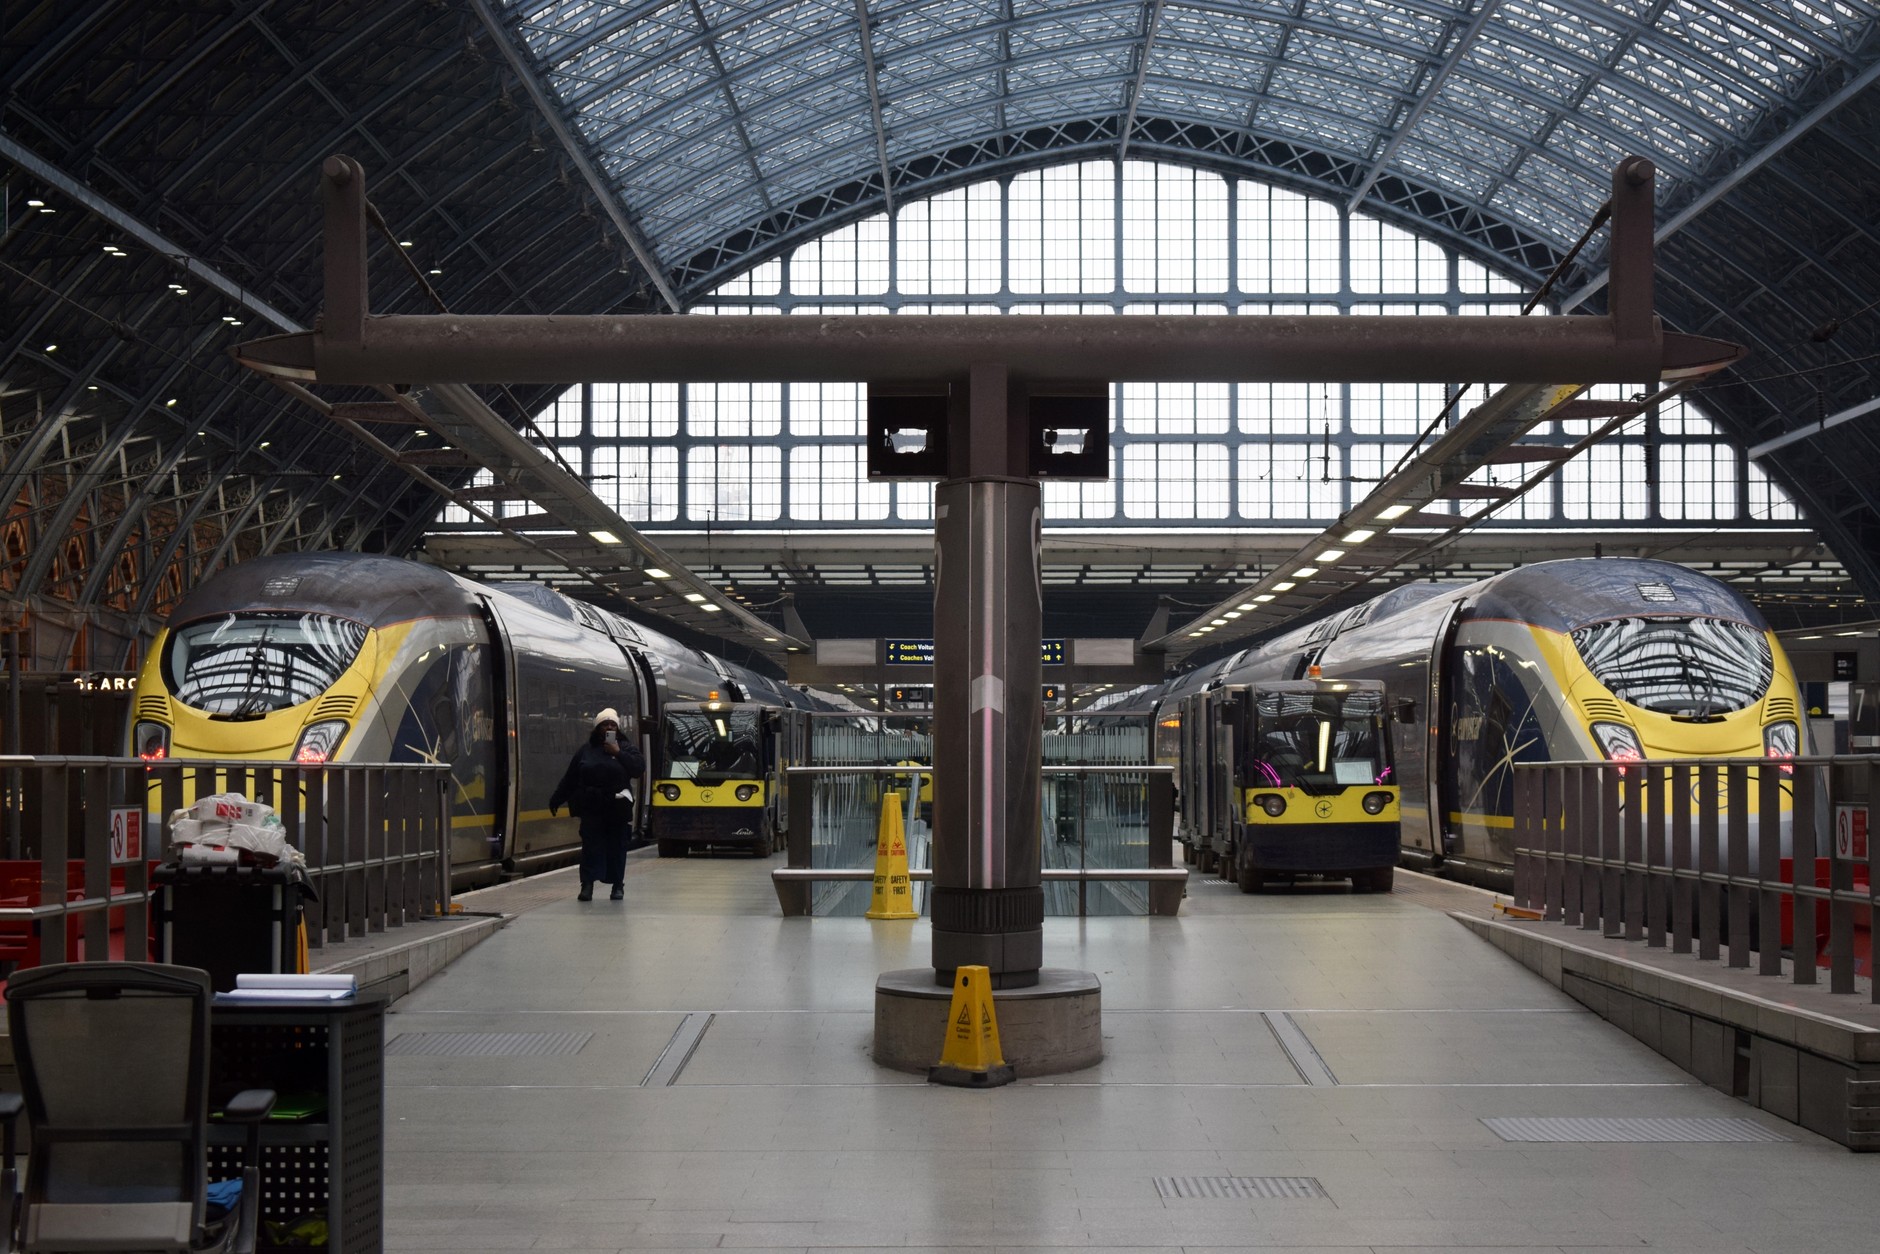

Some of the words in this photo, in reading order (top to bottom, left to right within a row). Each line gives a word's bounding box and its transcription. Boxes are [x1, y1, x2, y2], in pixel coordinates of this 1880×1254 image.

[896, 689, 903, 700] 5
[1046, 688, 1054, 698] 6
[1855, 688, 1866, 722] 7
[890, 875, 908, 884] SAFETY
[892, 886, 906, 895] FIRST
